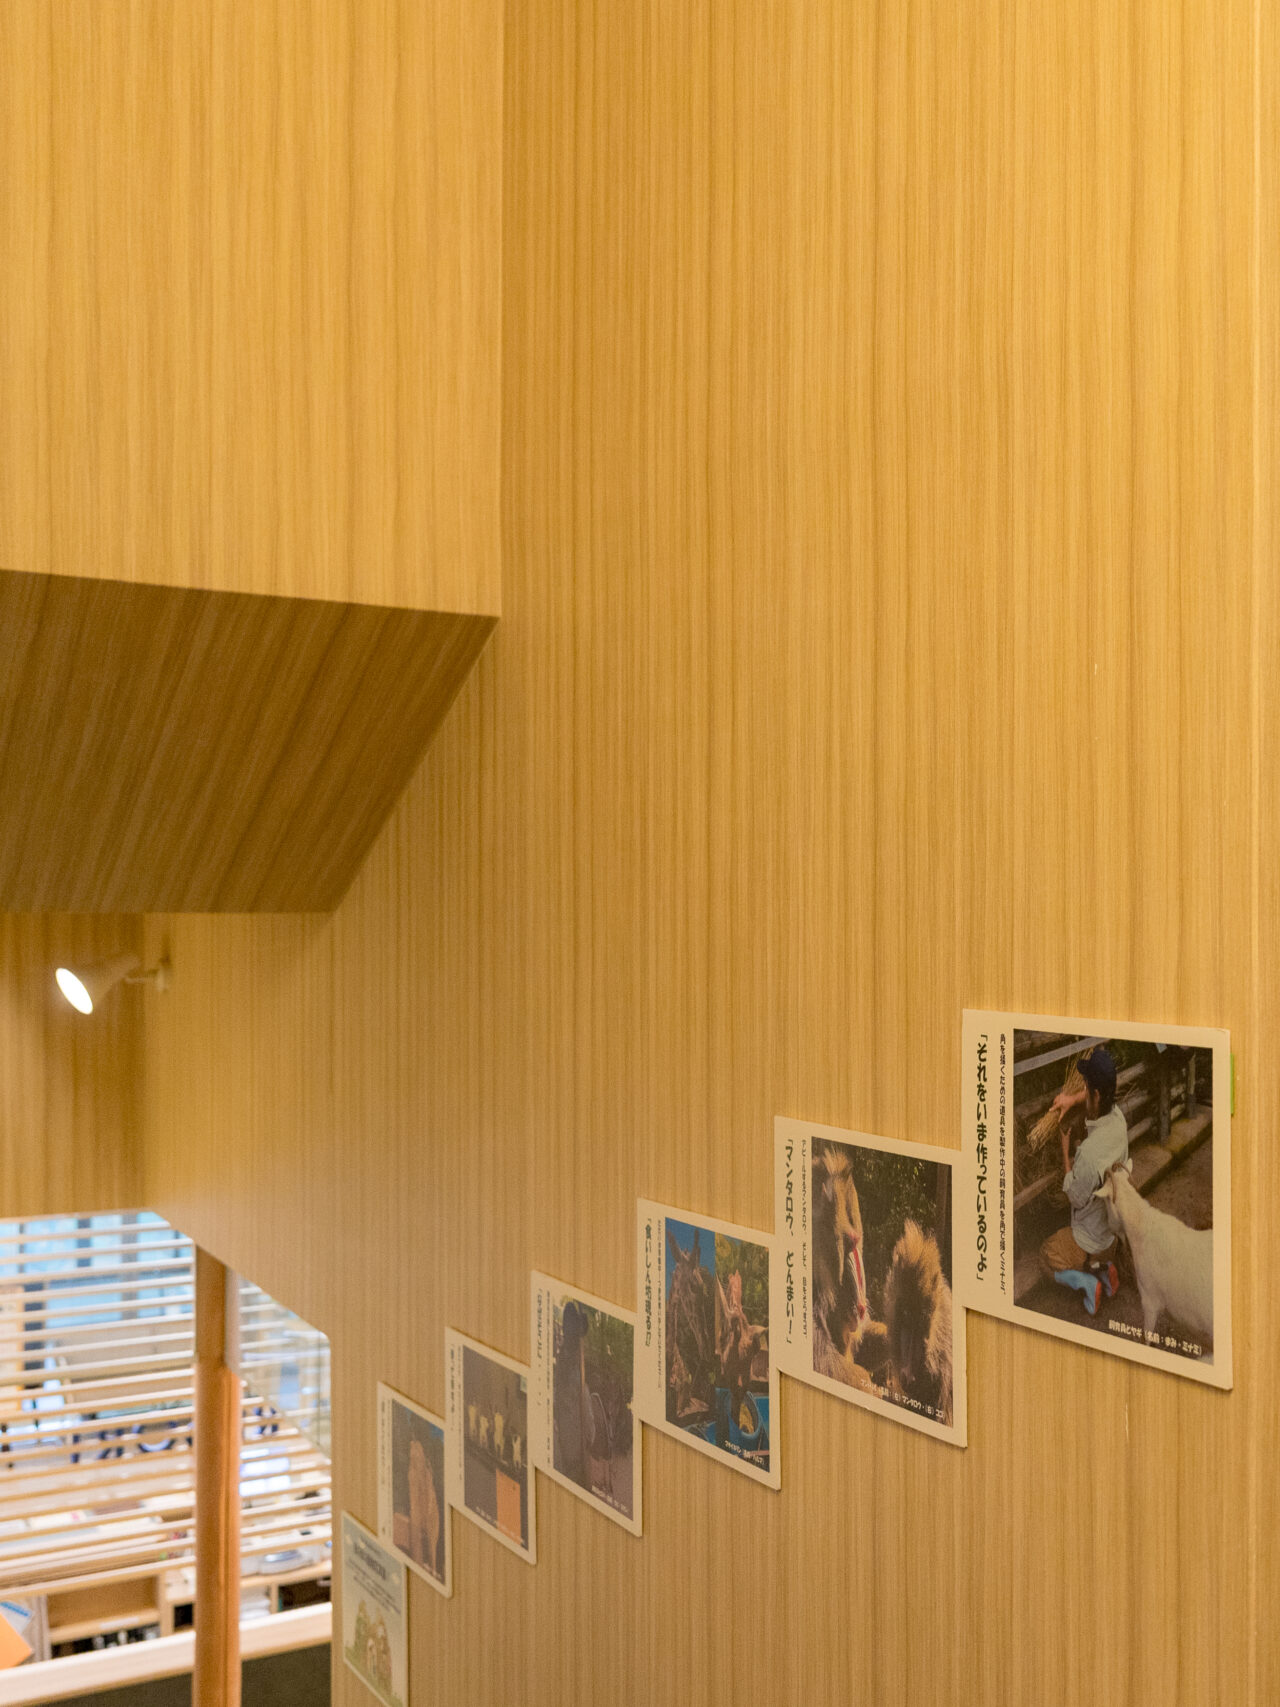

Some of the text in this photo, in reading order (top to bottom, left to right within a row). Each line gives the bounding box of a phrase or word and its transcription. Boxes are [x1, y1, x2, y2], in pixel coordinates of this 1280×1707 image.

[975, 1032, 989, 1282] 「それをいま作っているのよ」
